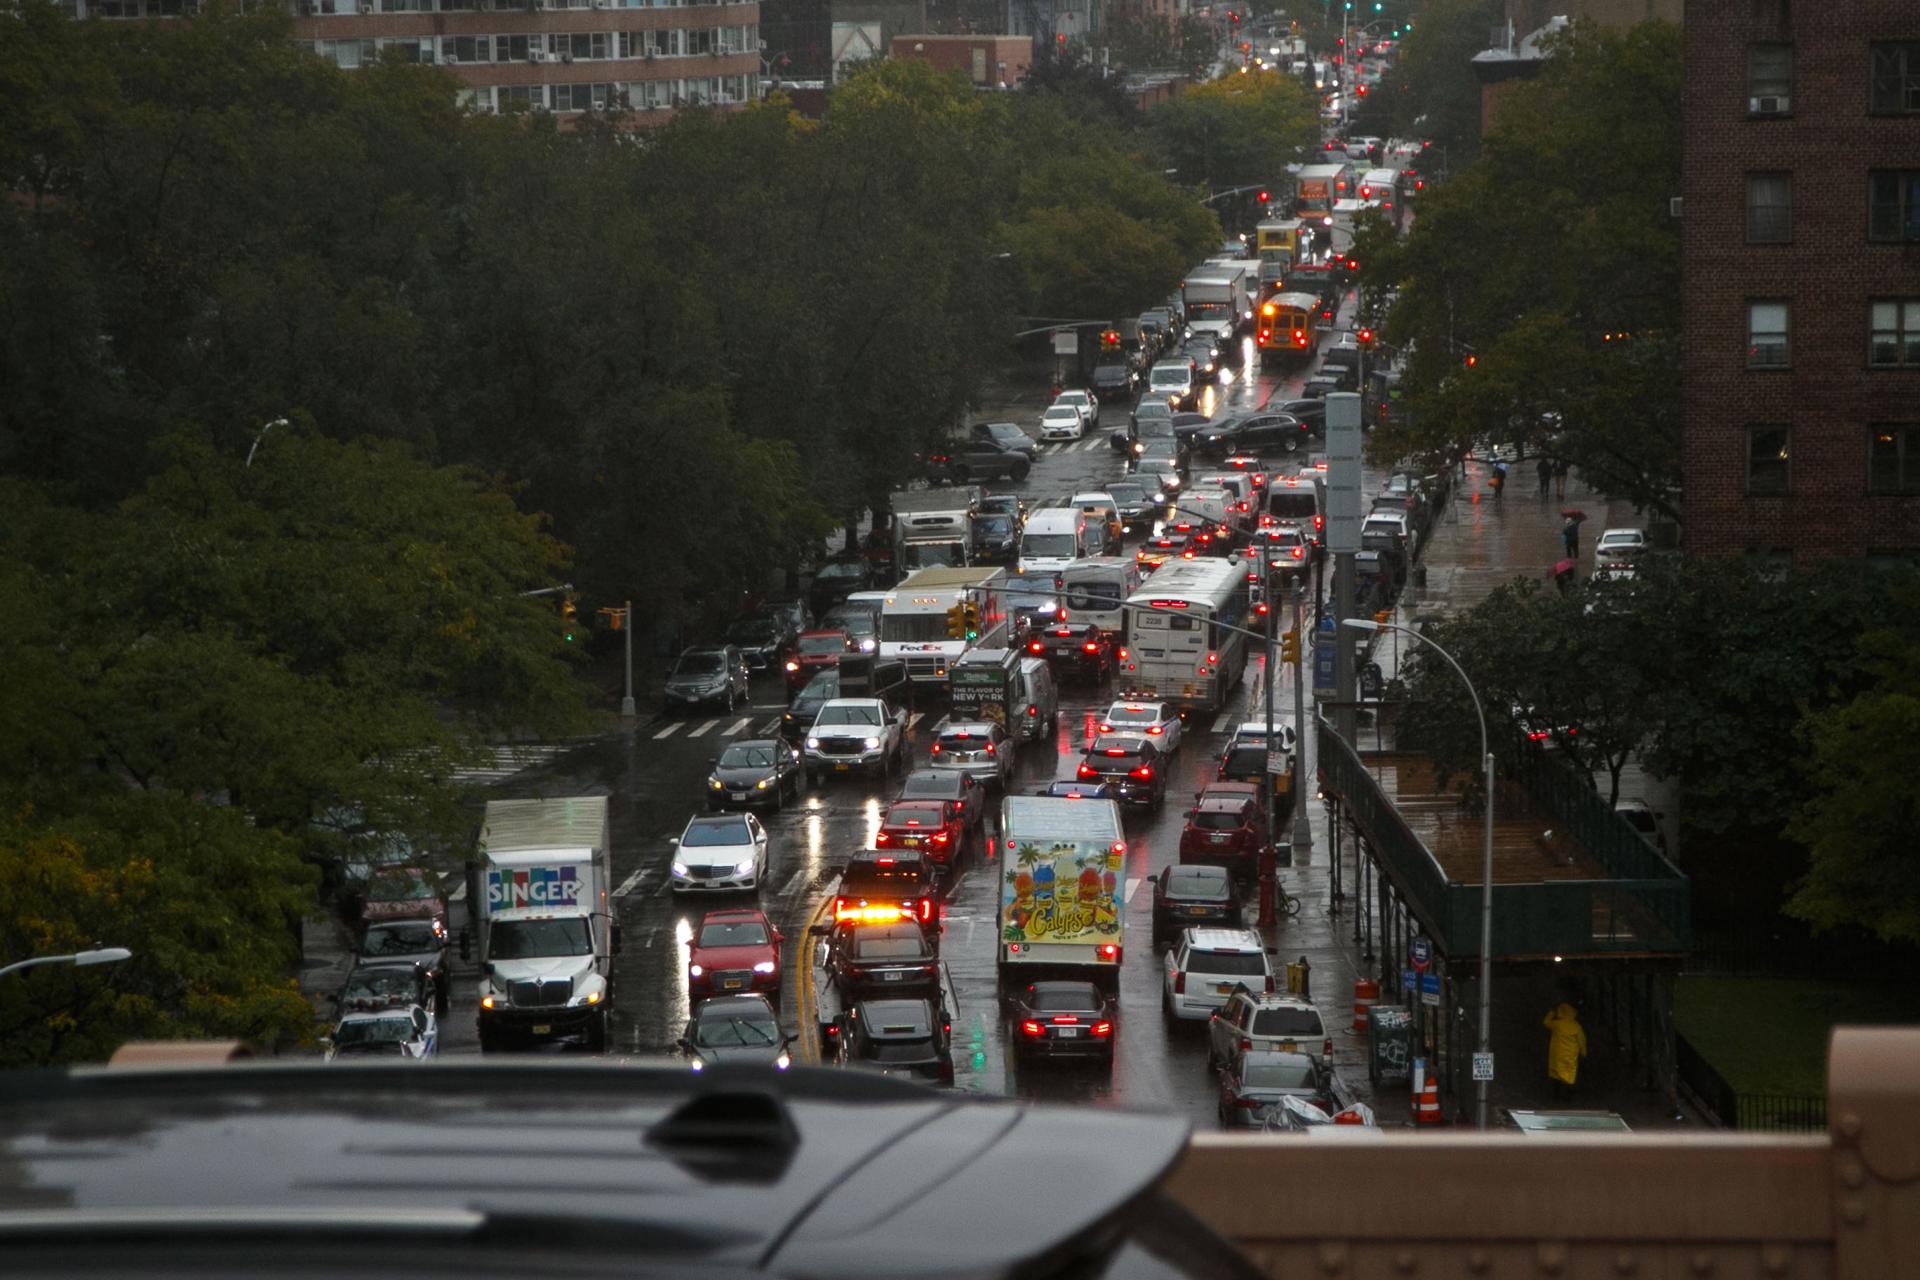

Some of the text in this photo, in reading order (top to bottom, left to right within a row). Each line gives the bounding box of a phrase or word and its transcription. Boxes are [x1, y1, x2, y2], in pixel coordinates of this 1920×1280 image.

[900, 644, 943, 652] FedEx
[953, 693, 976, 701] NEW
[489, 880, 578, 904] SINGER
[1031, 907, 1095, 936] Calypso
